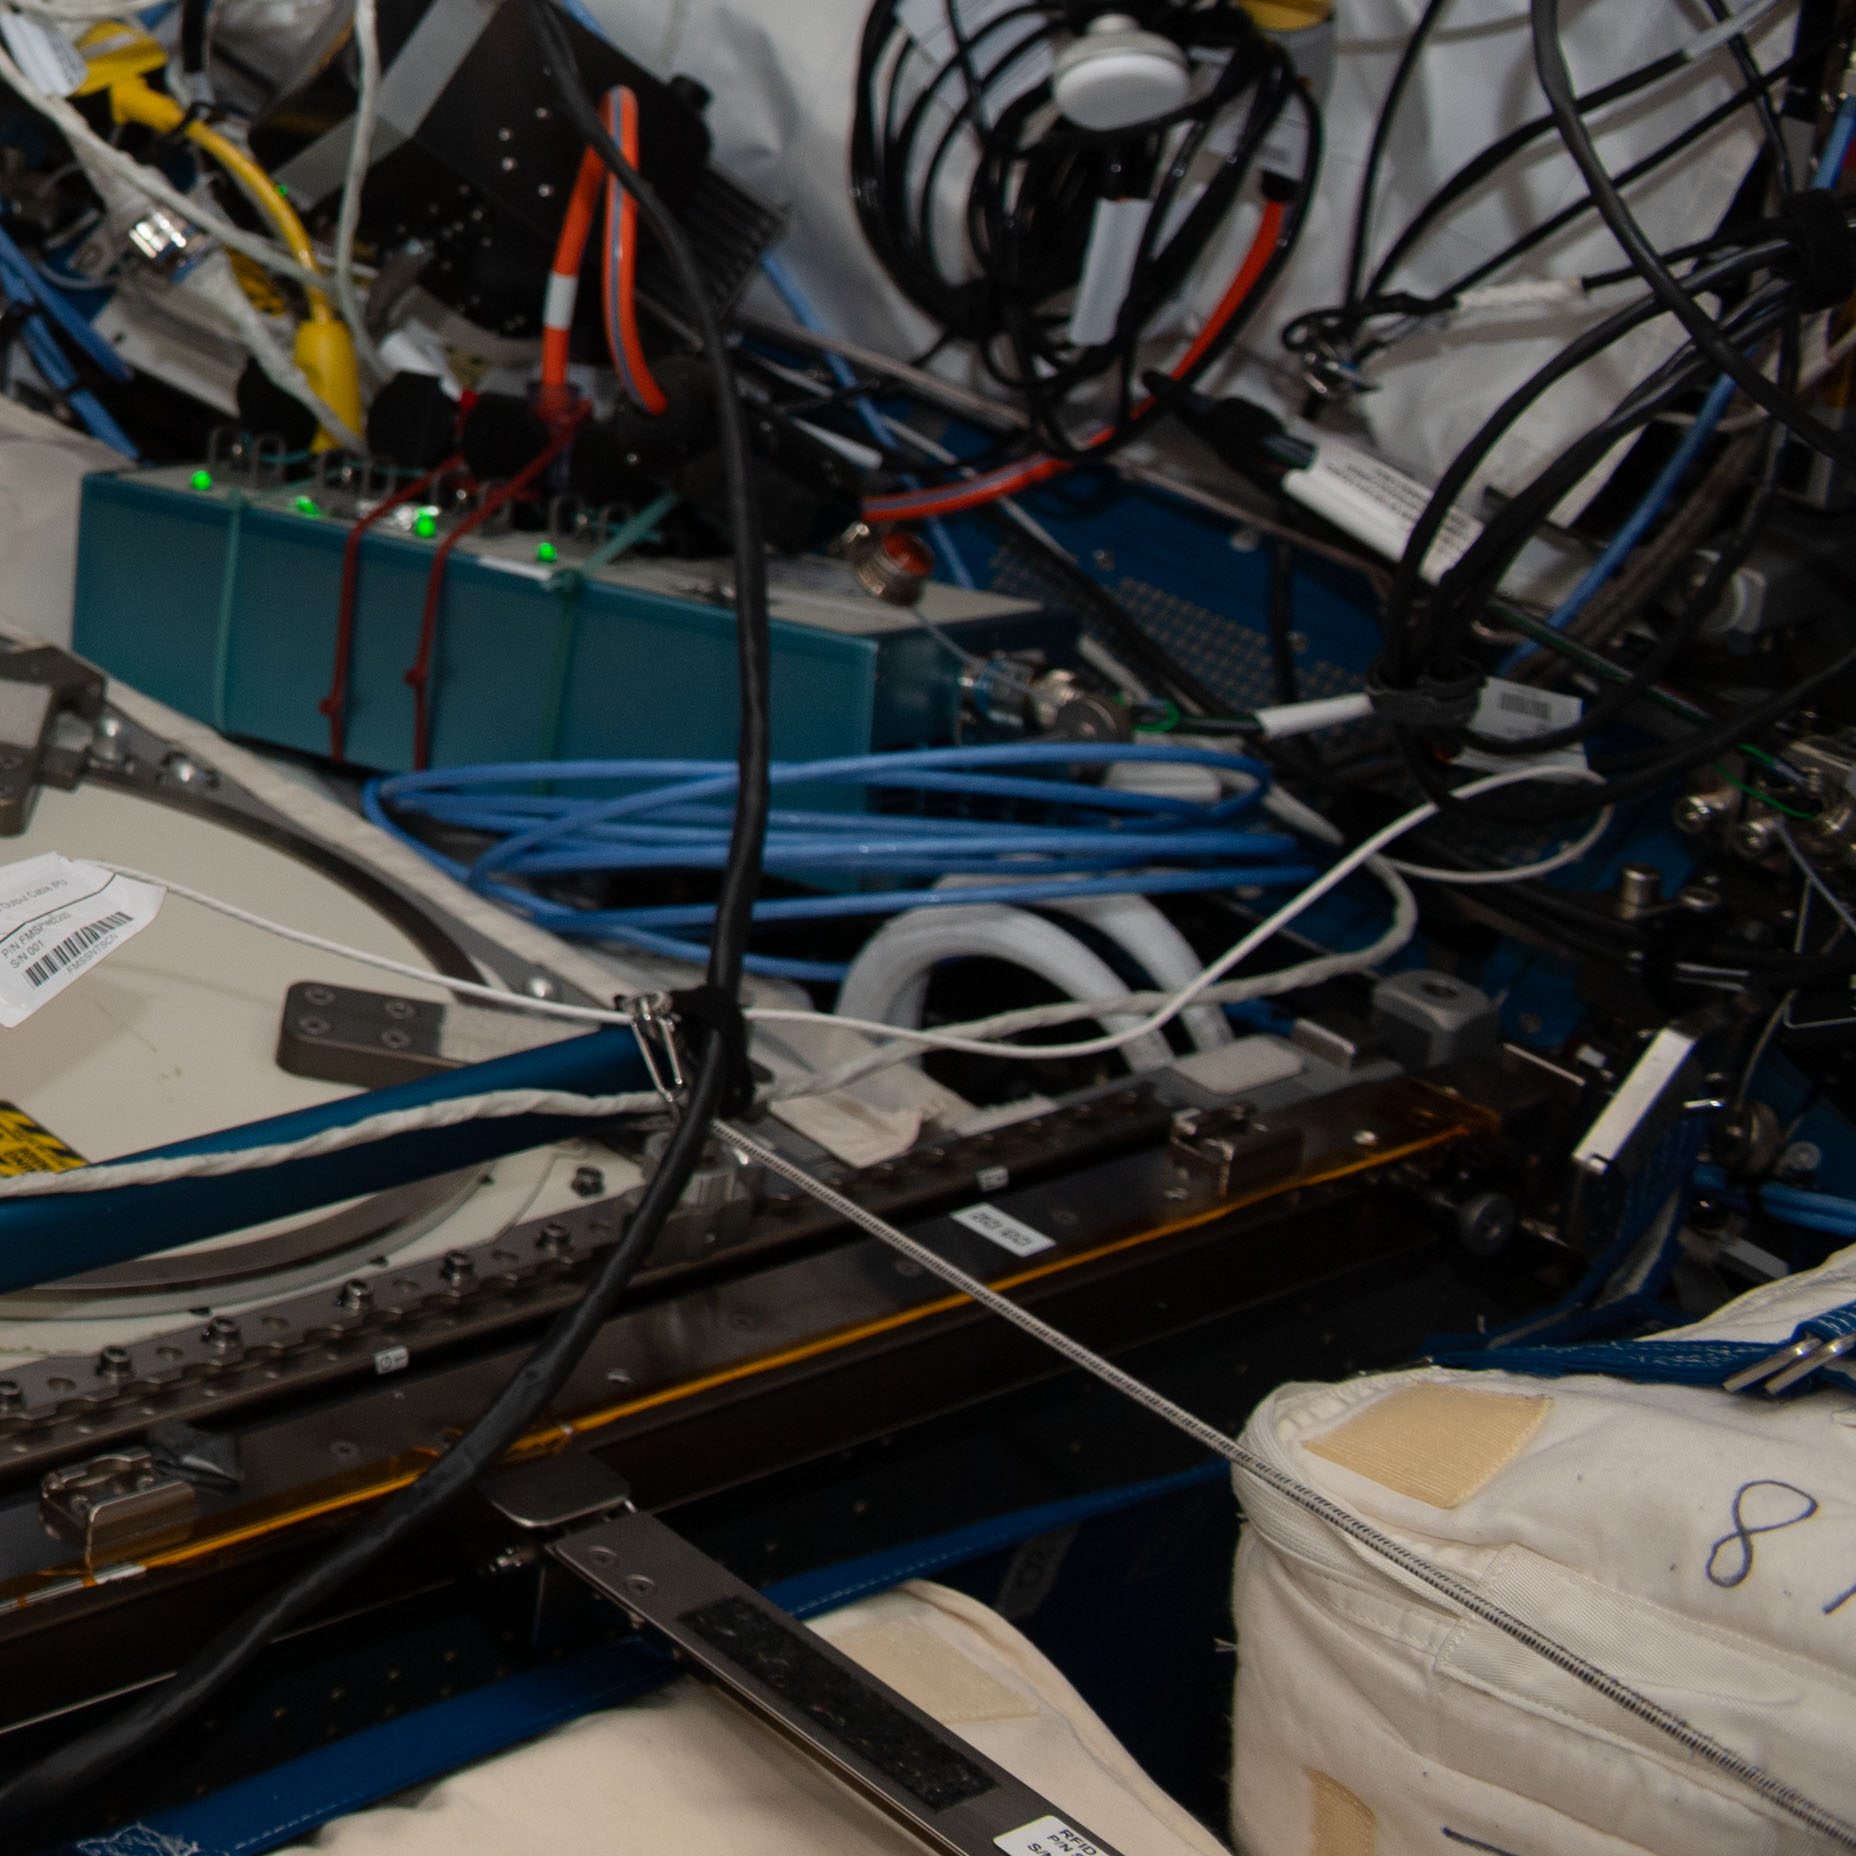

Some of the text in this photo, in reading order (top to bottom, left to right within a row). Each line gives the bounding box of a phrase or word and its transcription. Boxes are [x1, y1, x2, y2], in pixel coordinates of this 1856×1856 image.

[0, 940, 20, 958] P/N
[8, 938, 45, 968] S/N 001
[1706, 1479, 1818, 1588] 8
[1047, 1834, 1073, 1852] P/N
[1059, 1829, 1097, 1855] RFID
